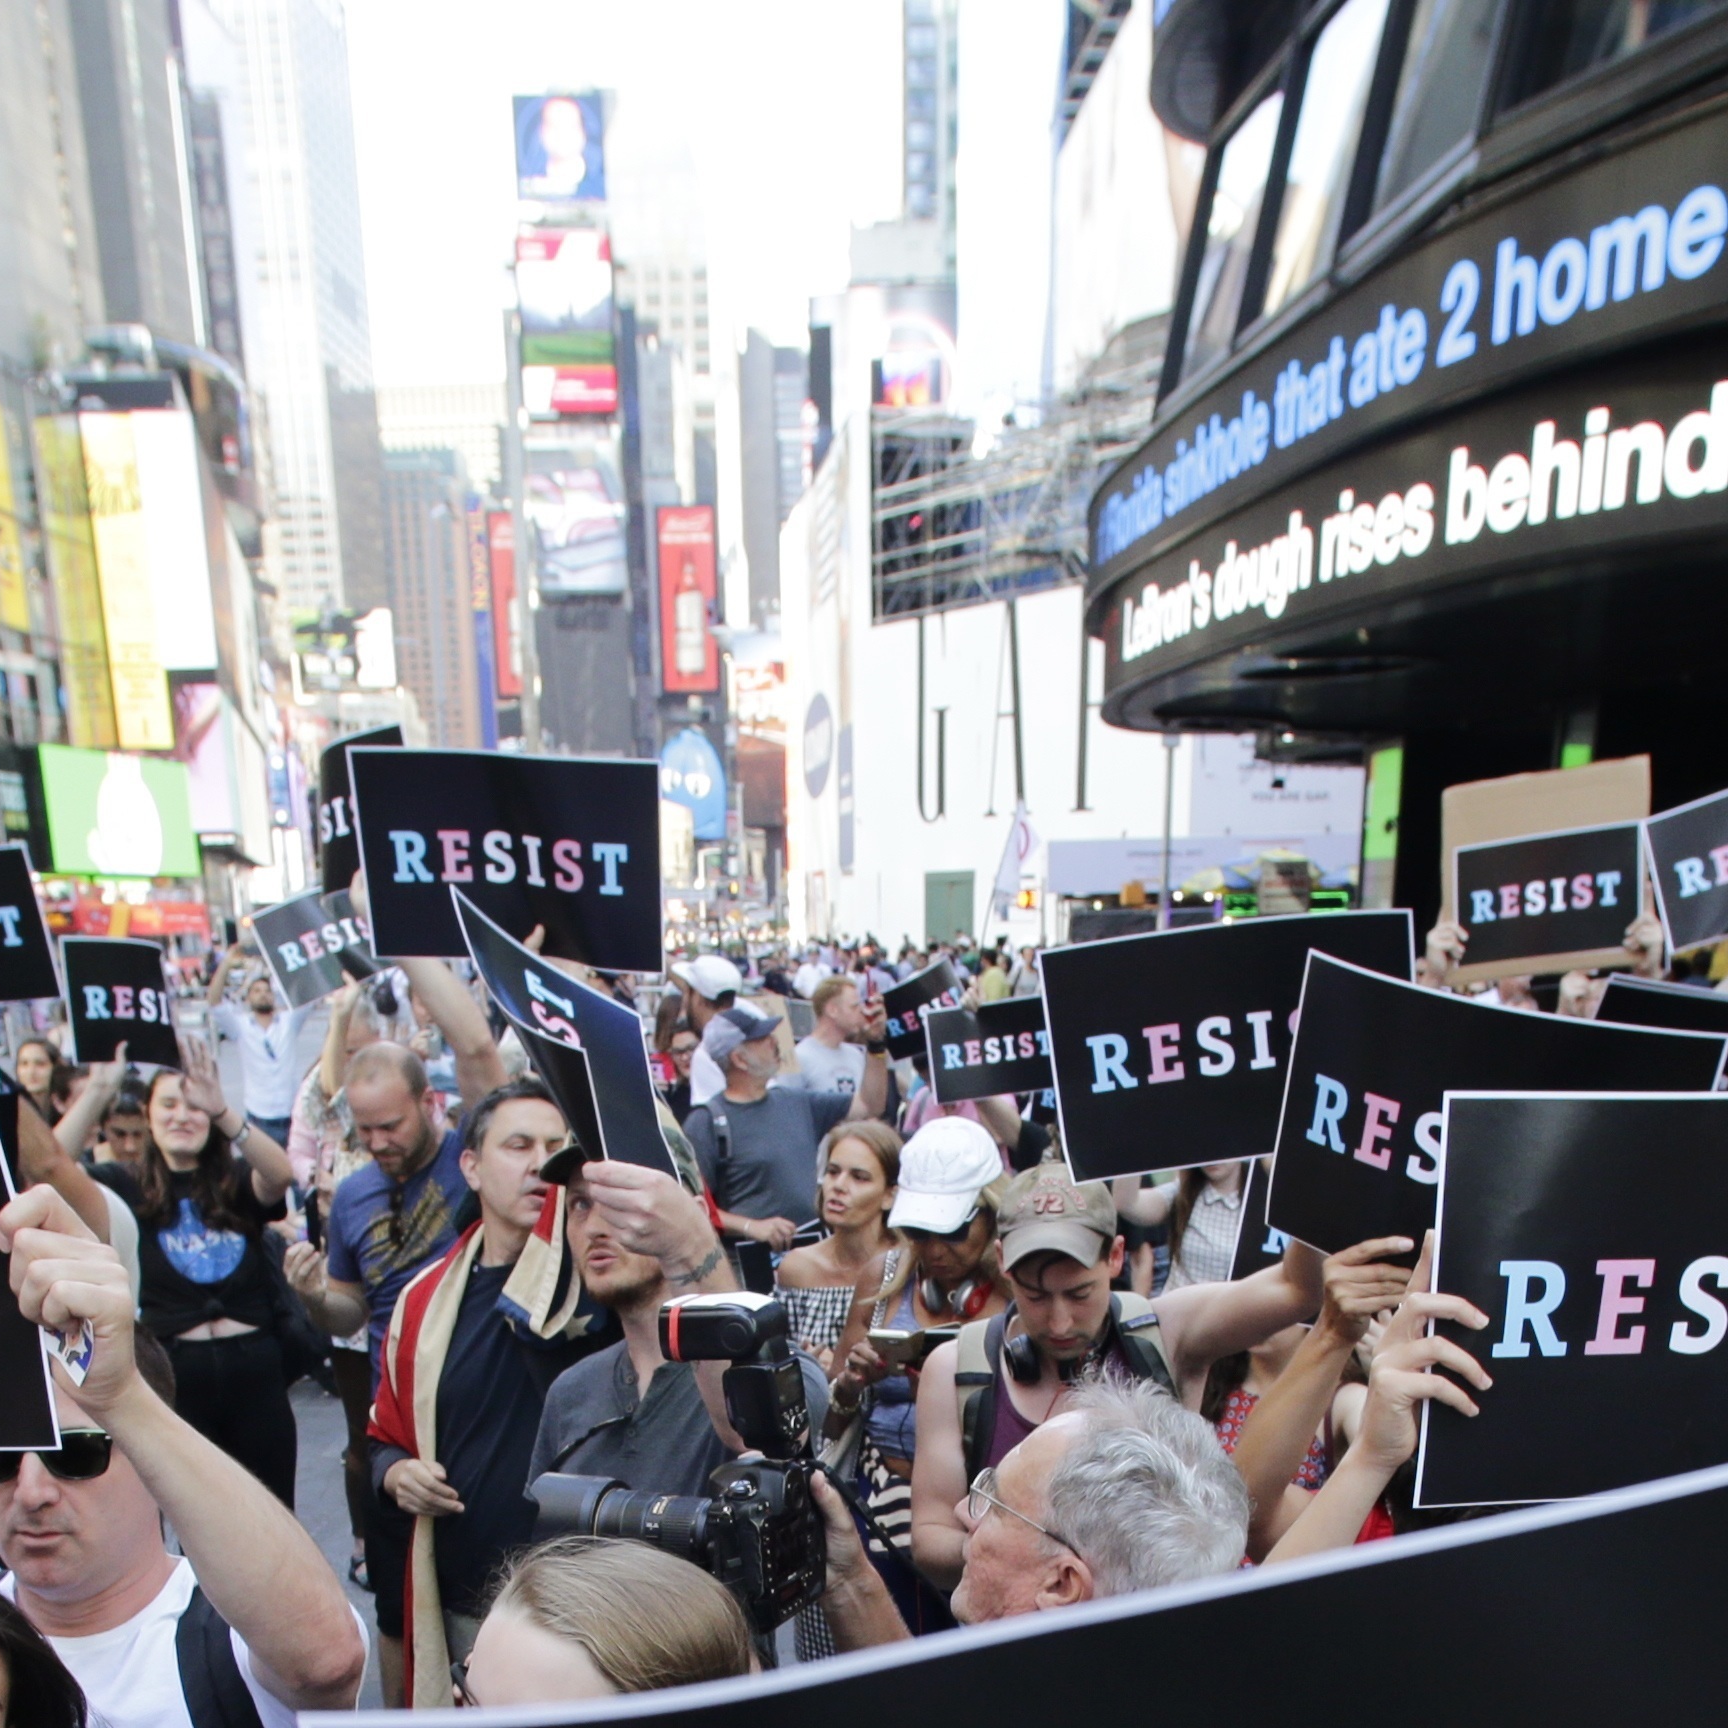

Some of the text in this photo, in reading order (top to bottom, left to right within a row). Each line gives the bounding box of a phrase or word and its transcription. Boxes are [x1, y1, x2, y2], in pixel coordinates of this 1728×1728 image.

[1164, 390, 1270, 517] sinkhole
[1273, 336, 1345, 449] that
[1348, 304, 1427, 409] ate
[1436, 260, 1480, 368] 2
[1122, 559, 1212, 663] LeBron's
[1213, 510, 1313, 619] dough
[1319, 487, 1434, 584] rises
[388, 829, 628, 896] RESIST
[1471, 870, 1622, 925] RESIST
[1086, 1007, 1299, 1094] RESI
[1034, 1191, 1065, 1215] 72
